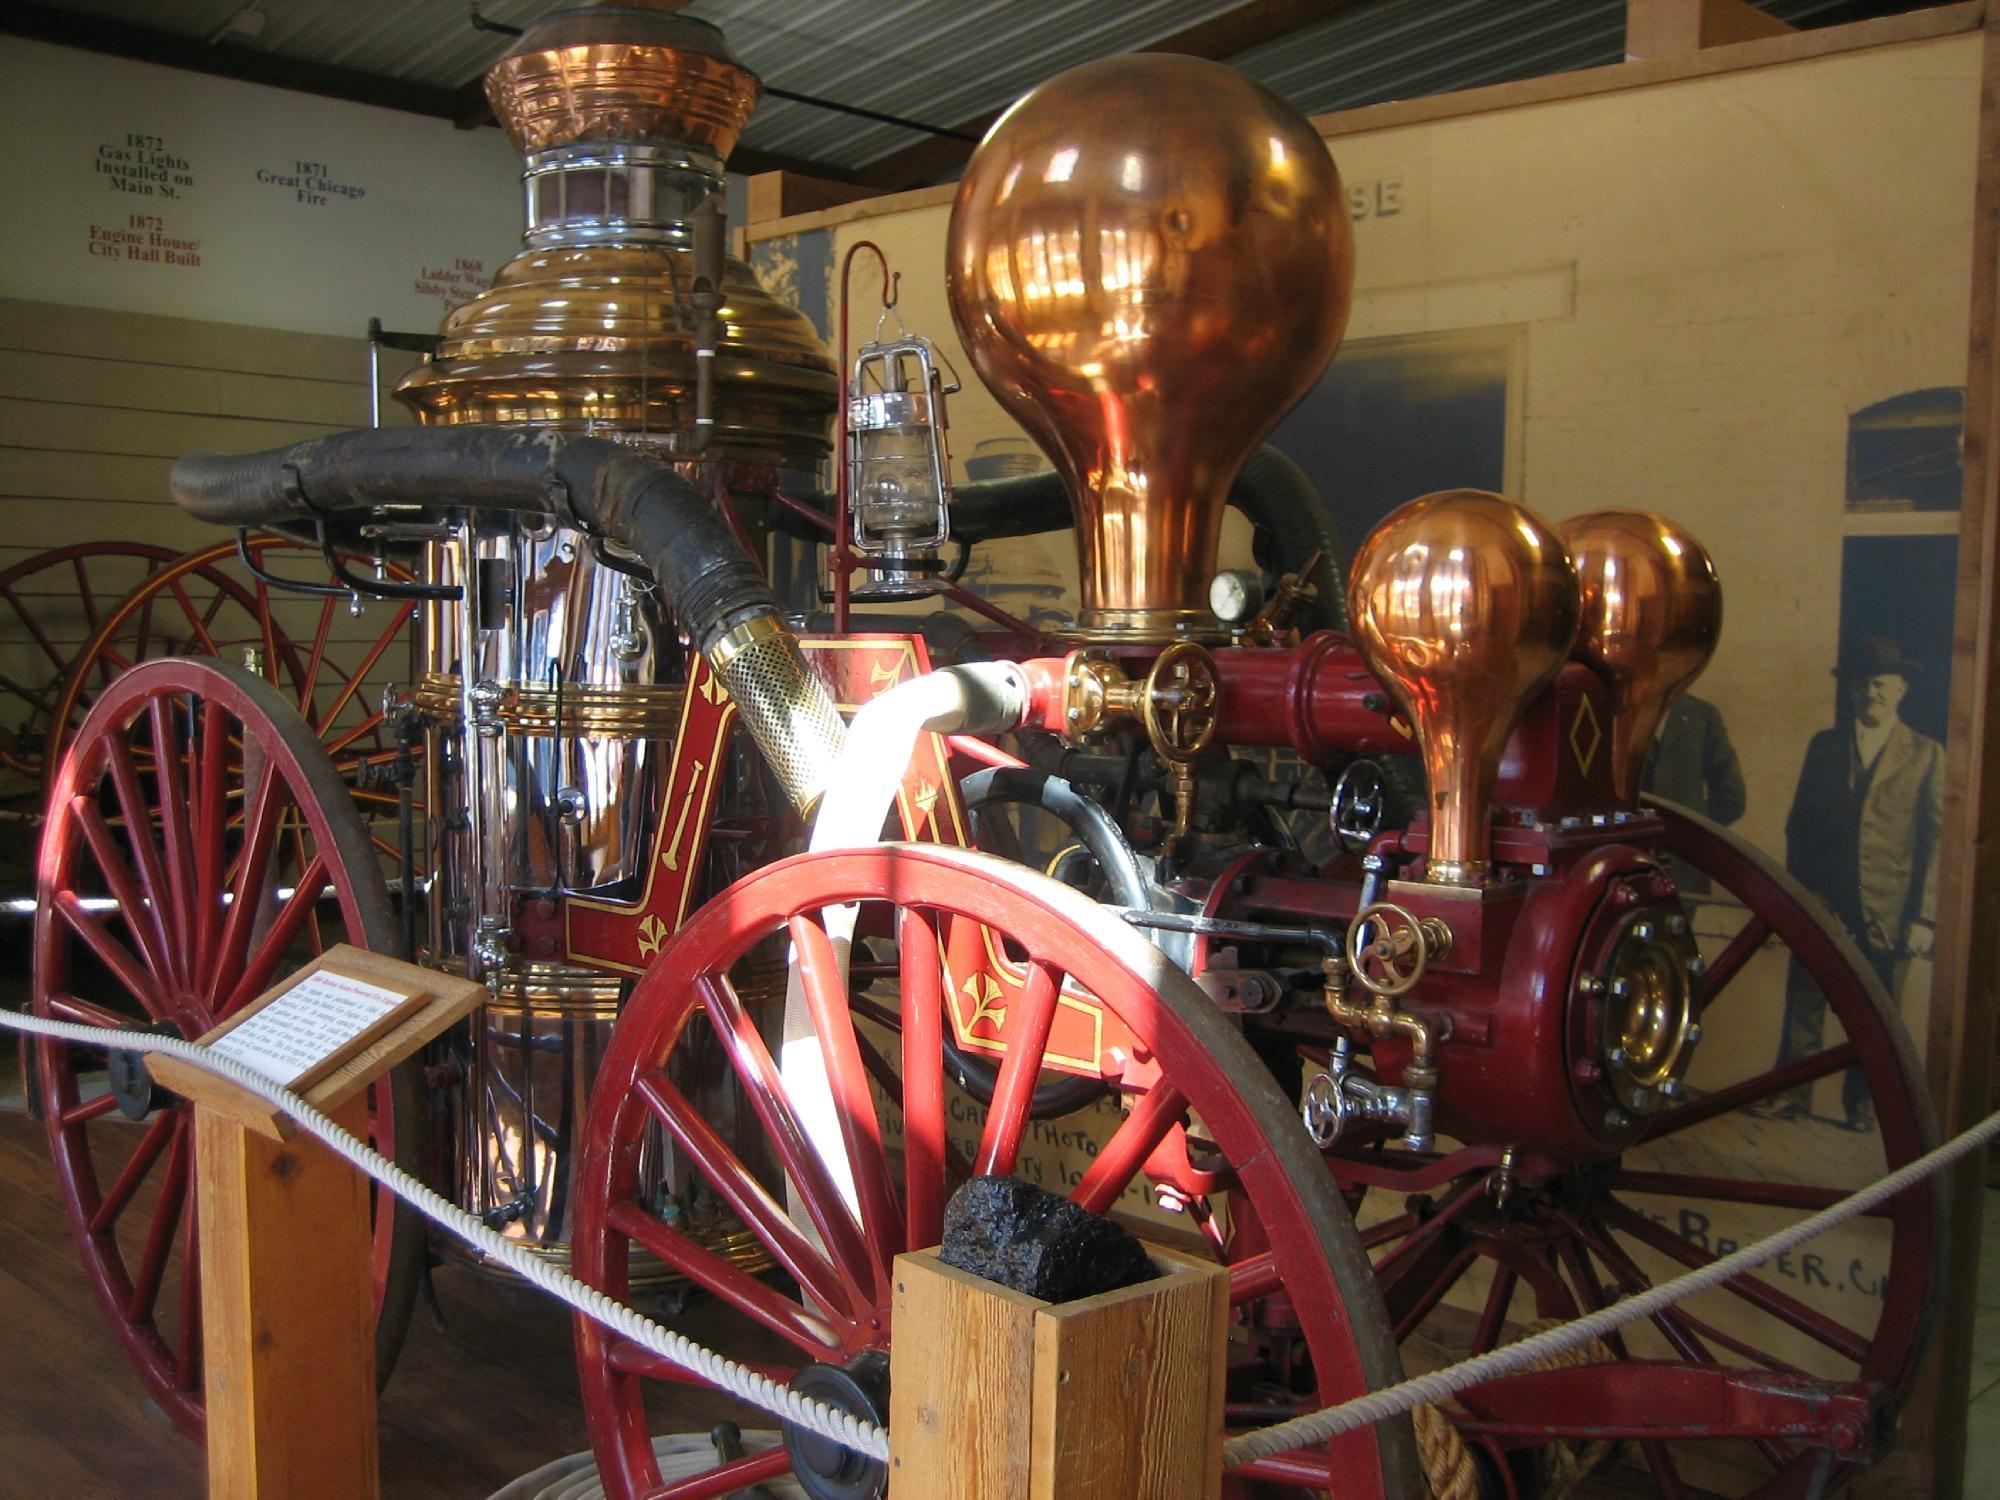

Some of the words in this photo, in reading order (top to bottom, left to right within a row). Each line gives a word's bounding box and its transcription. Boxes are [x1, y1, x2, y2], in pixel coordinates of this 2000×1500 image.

[127, 133, 163, 151] 1872
[99, 144, 131, 160] Gas
[139, 151, 190, 170] Lights
[95, 159, 168, 182] Installed
[174, 175, 193, 187] on
[296, 161, 327, 178] 1871
[111, 176, 153, 195] Main
[160, 184, 181, 199] St.
[257, 169, 300, 188] Great
[305, 176, 366, 199] Chicago
[297, 189, 327, 206] Fire
[1345, 178, 1402, 221] SE
[129, 214, 163, 231] 1872
[90, 225, 145, 245] Engine
[89, 241, 120, 261] City
[128, 245, 160, 262] Hall
[165, 250, 201, 267] Built
